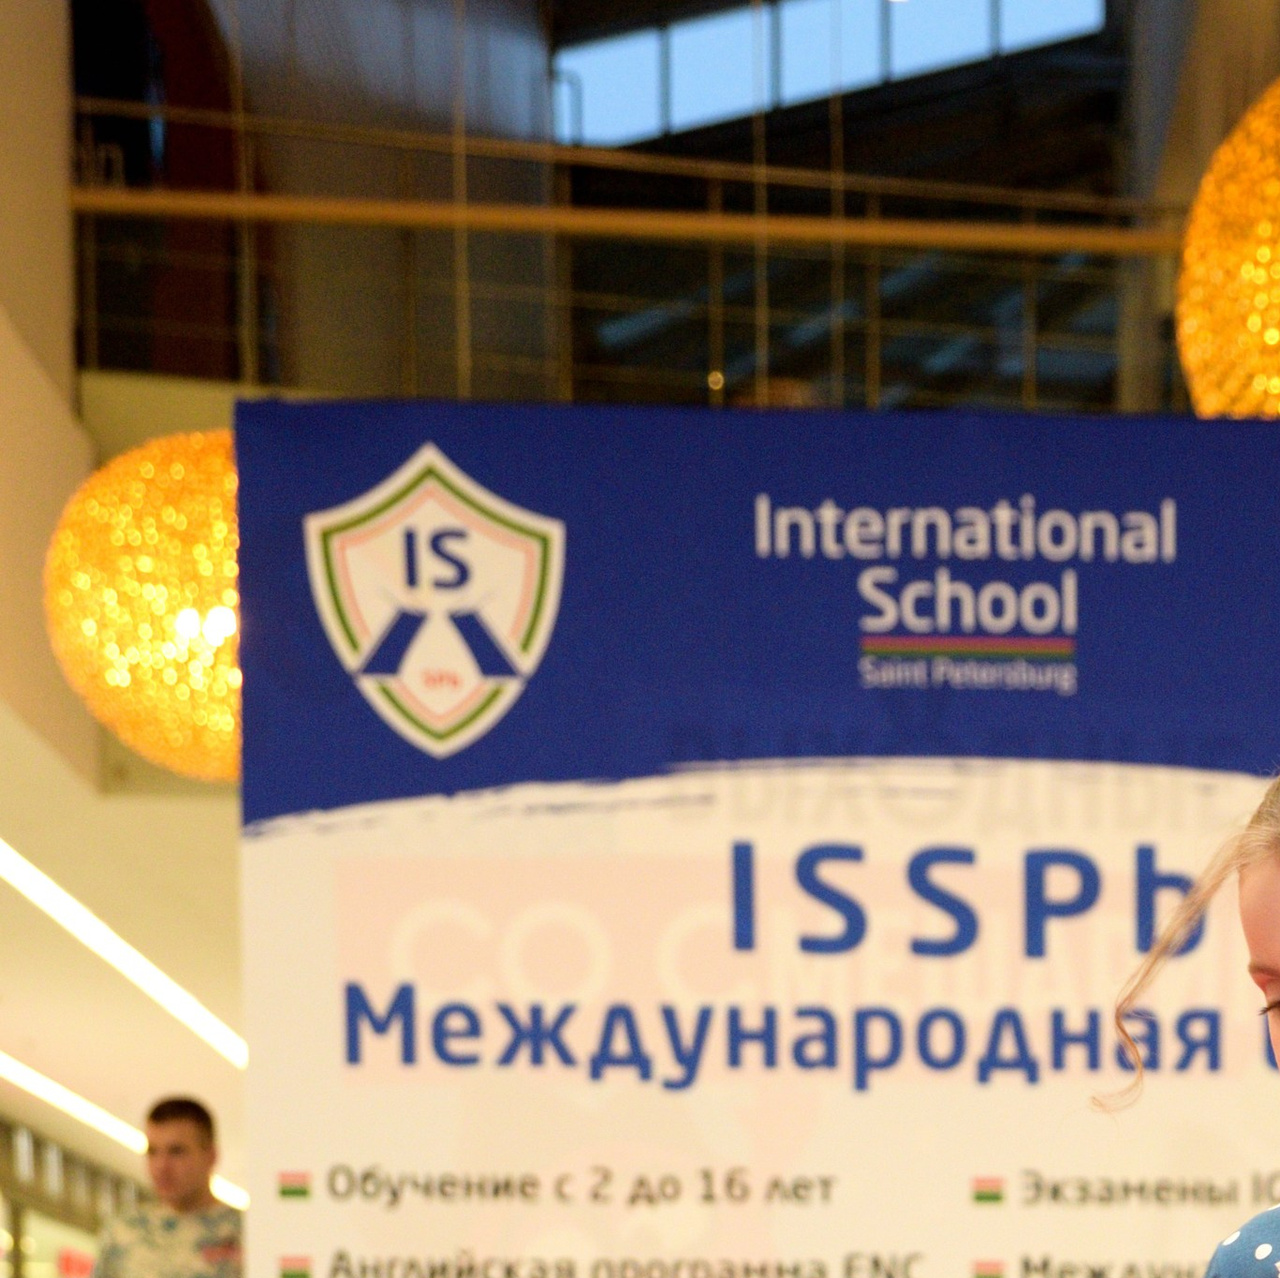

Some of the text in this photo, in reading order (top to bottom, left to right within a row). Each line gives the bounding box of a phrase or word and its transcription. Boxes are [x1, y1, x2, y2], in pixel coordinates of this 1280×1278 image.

[403, 528, 470, 590] IS
[754, 493, 1177, 564] International
[857, 565, 1078, 635] School
[858, 655, 1078, 696] Saint Petersburg
[731, 839, 1208, 958] ISSPb
[342, 982, 1222, 1091] Международная
[326, 1162, 835, 1209] Обучение с 2 до 16 лет
[1018, 1168, 1238, 1207] Экзамены
